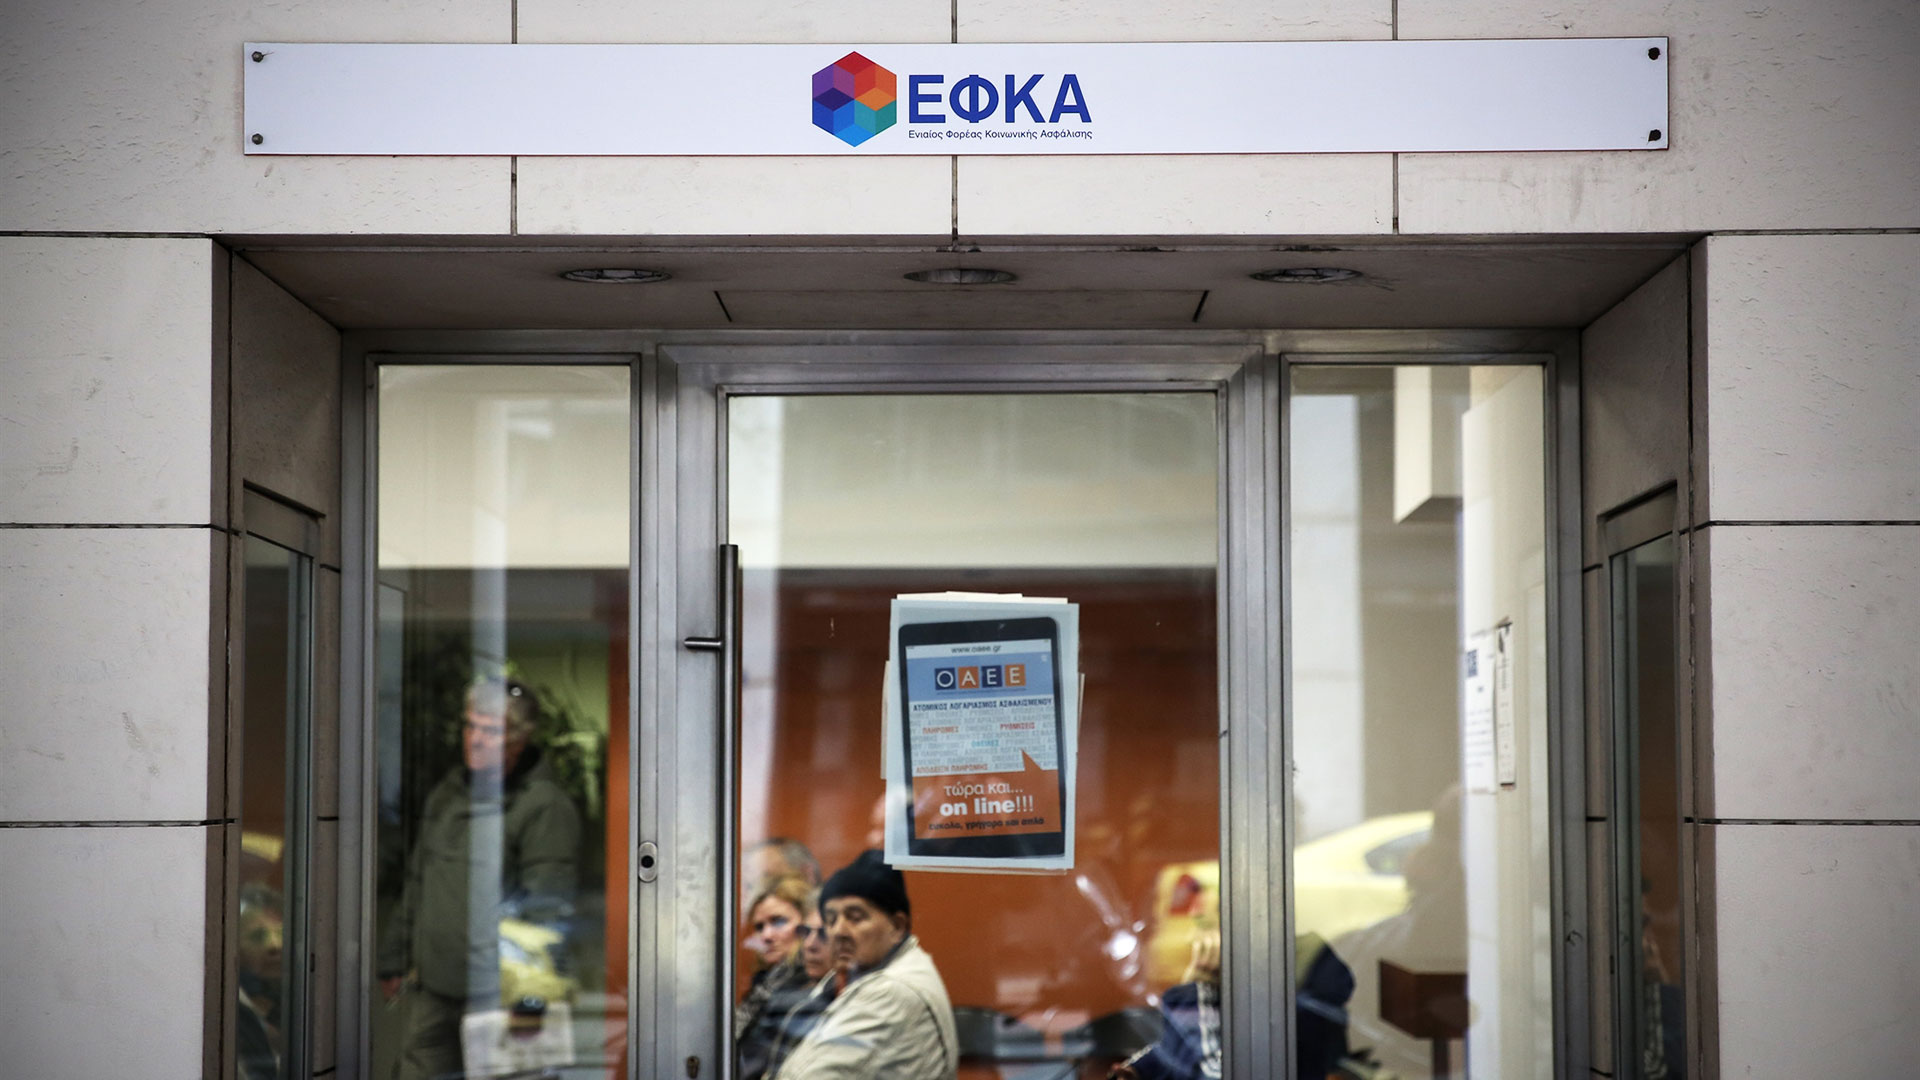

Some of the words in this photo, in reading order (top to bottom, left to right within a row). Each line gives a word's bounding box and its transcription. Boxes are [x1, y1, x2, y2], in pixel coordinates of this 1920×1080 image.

[908, 74, 1092, 123] ΕΦΚΑ
[908, 129, 943, 140] Ενιαίος
[945, 129, 982, 140] Φορέας
[985, 129, 1037, 140] Κοινωνικής
[1040, 129, 1092, 140] Ασφάλισης
[951, 645, 1001, 654] www.oaee.gr
[944, 781, 984, 798] τώρα
[940, 802, 968, 816] on
[974, 795, 1034, 815] line!!!
